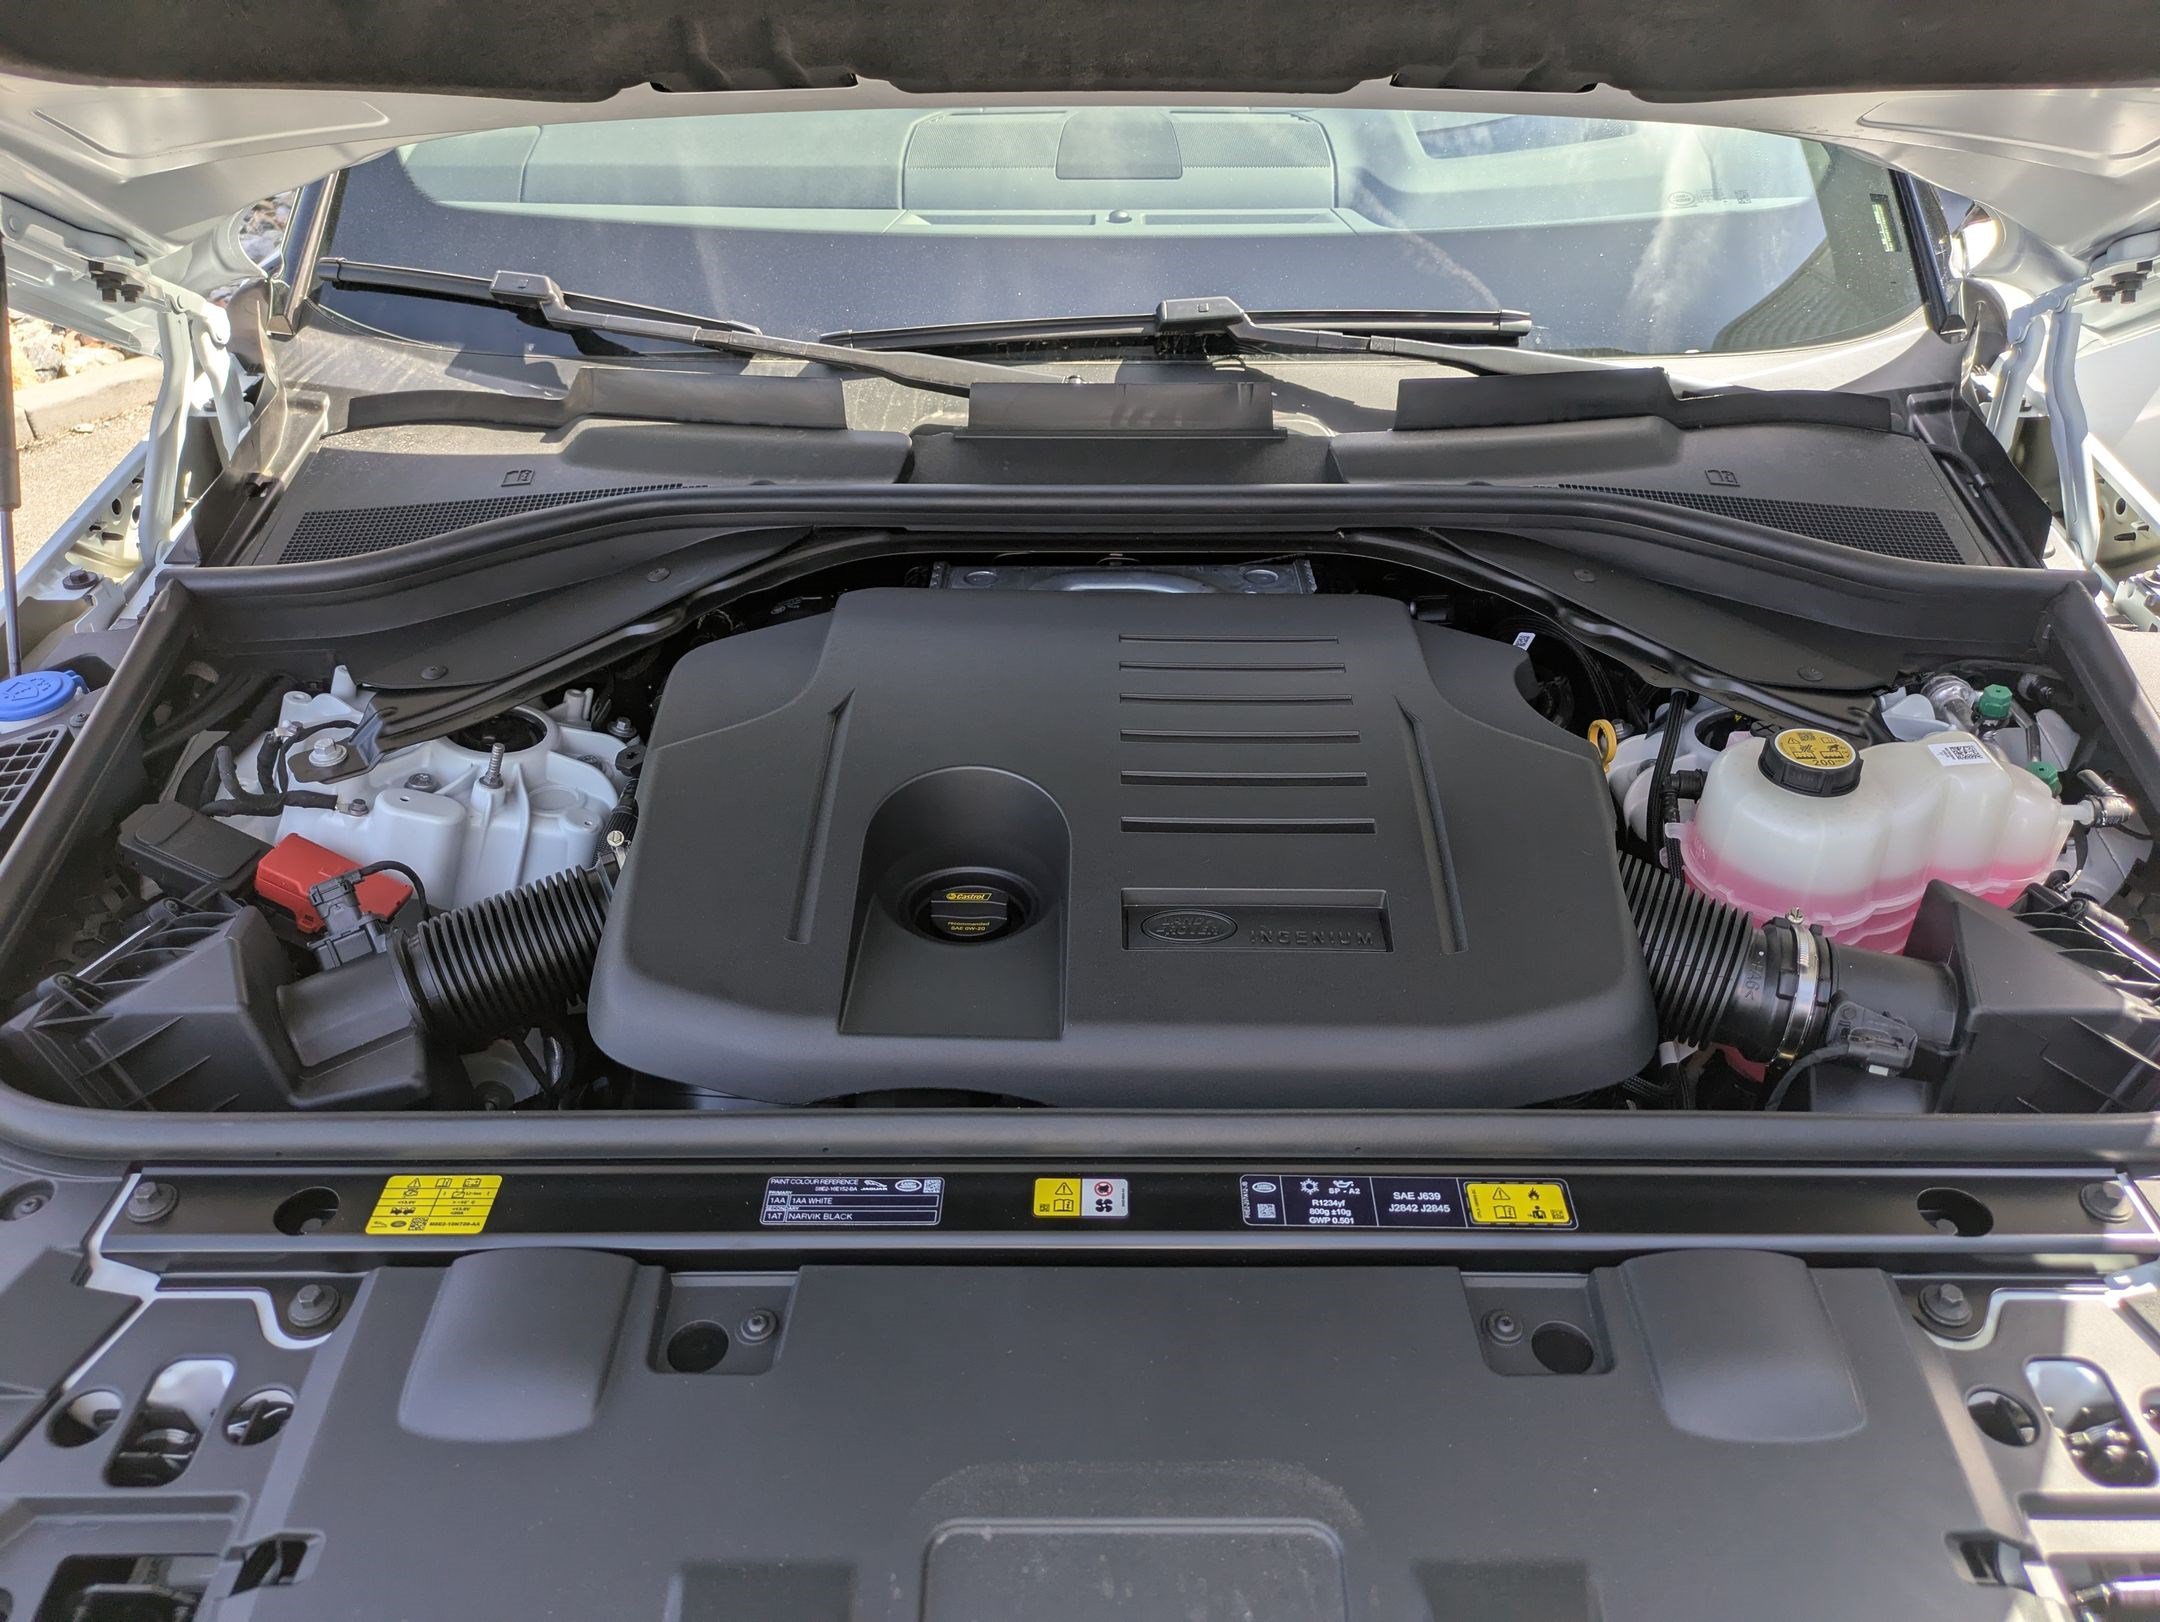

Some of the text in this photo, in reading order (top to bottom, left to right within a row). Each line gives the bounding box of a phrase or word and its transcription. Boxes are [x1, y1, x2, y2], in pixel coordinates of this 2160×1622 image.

[1250, 929, 1374, 945] INGENIUM
[1392, 1191, 1441, 1200] SAE J639
[808, 1197, 833, 1205] WHITE
[1312, 1199, 1346, 1207] R1234yf
[1309, 1208, 1352, 1216] 800g ±10g
[1388, 1204, 1451, 1213] J2842 J2845
